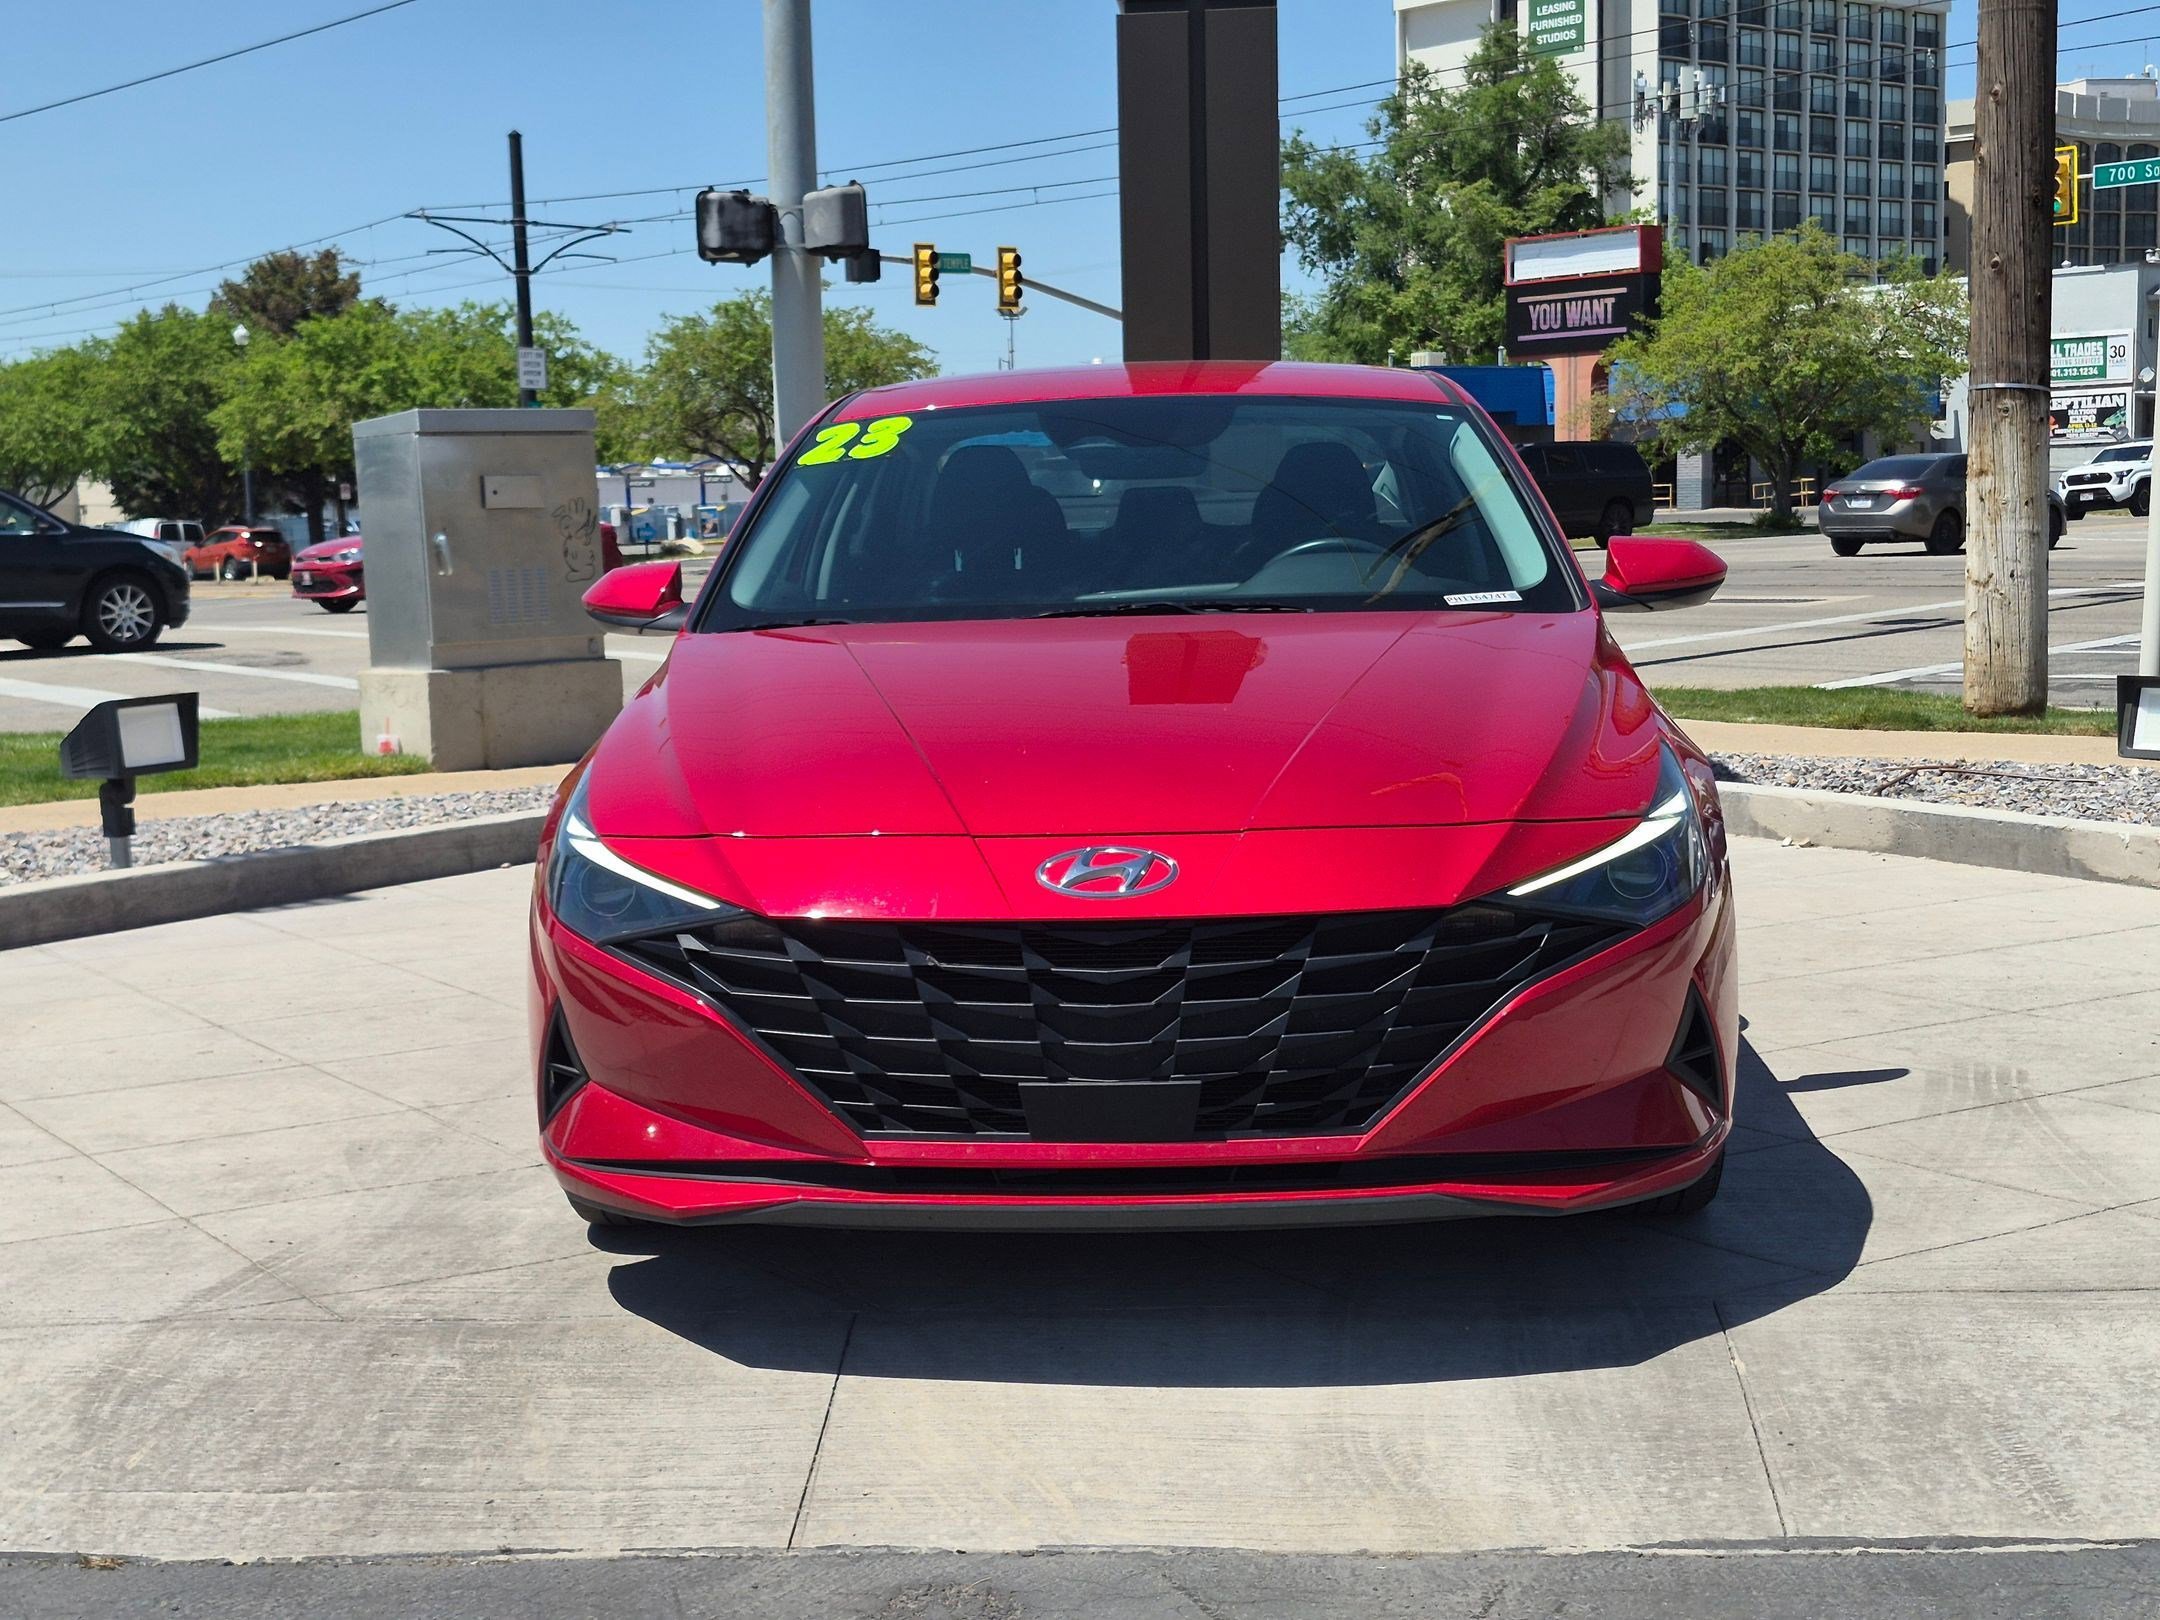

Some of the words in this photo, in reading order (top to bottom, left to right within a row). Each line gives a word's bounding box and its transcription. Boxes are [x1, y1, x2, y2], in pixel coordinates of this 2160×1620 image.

[1536, 1, 1576, 16] LEASING
[1530, 14, 1582, 31] FURNISHED
[1536, 30, 1576, 45] STUDIOS
[2109, 166, 2136, 182] 700
[1528, 302, 1562, 331] YOU
[1565, 297, 1616, 328] WANT
[2063, 341, 2104, 357] TRADES
[2110, 345, 2126, 359] 30
[2069, 414, 2096, 424] EXPO
[797, 416, 913, 466] 23
